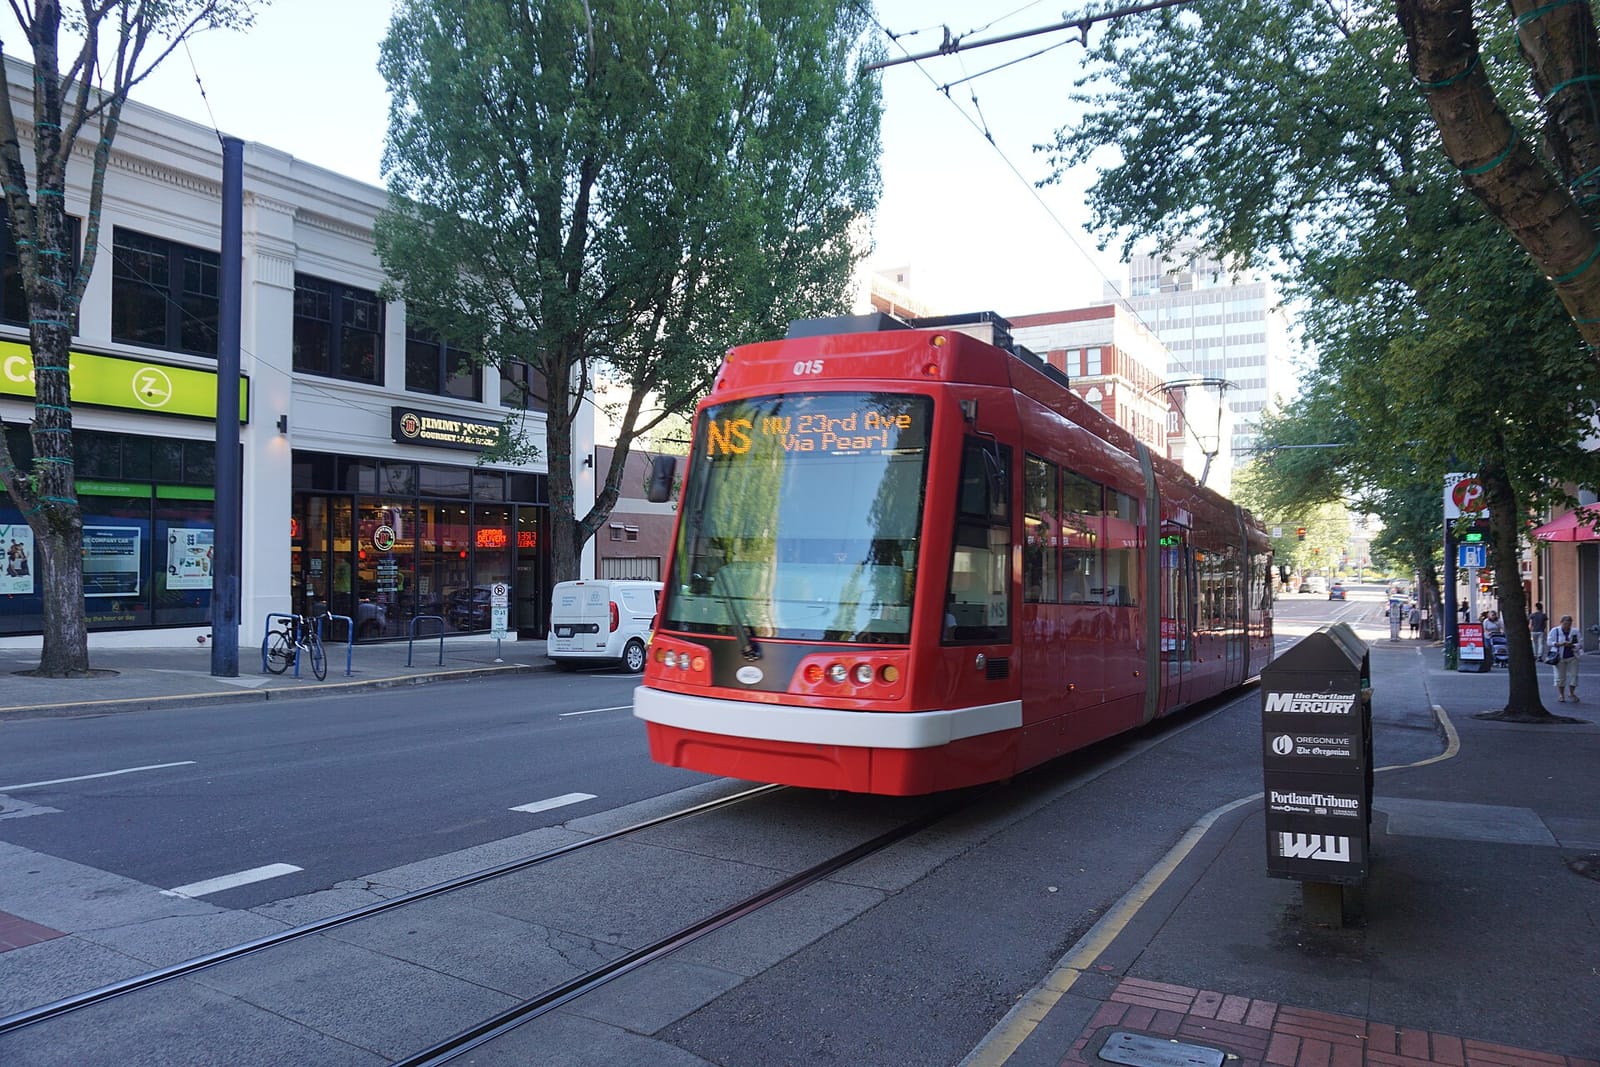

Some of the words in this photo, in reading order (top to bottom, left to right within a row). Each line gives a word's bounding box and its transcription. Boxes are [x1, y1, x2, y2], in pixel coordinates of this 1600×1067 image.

[793, 360, 824, 375] 015
[421, 417, 461, 433] JIMMY
[798, 412, 857, 434] 23rd
[864, 411, 912, 431] Ave
[708, 419, 752, 456] NS
[821, 430, 888, 451] Pearl
[1265, 693, 1354, 714] MERCURY
[1296, 736, 1349, 745] OREGONLIVE
[1296, 746, 1310, 755] The
[1312, 747, 1350, 756] Oregonian
[1271, 791, 1359, 809] PortlandTribune
